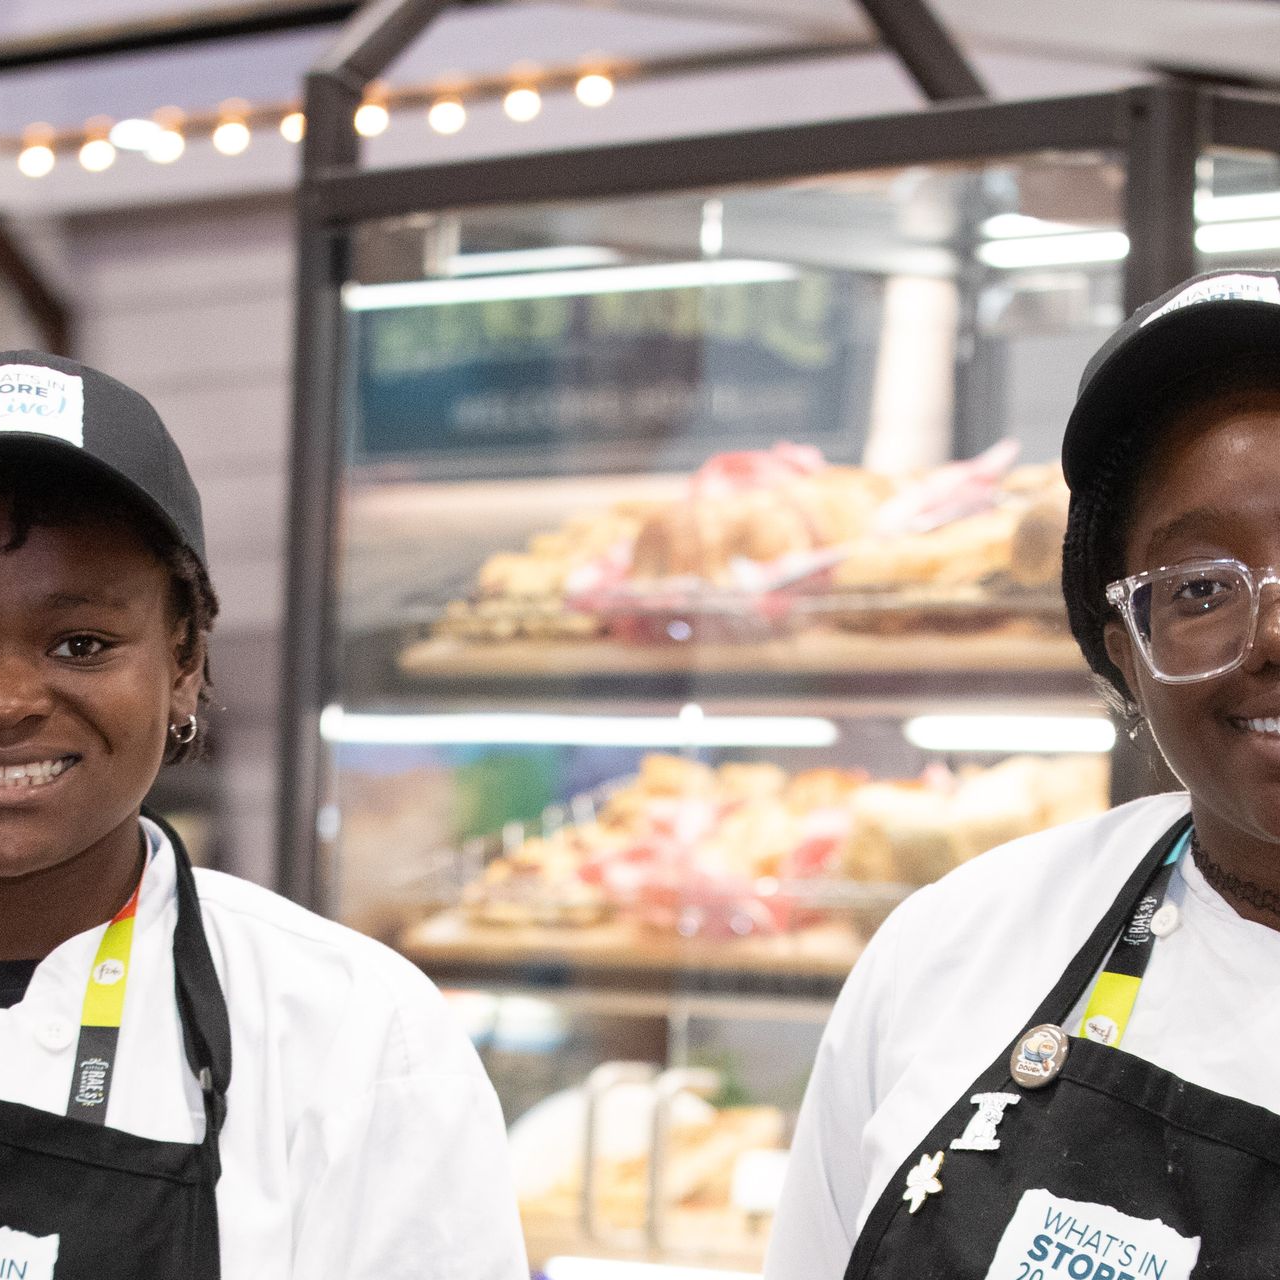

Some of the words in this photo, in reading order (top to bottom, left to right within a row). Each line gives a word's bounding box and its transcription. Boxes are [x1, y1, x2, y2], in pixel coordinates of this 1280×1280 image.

[48, 379, 66, 392] IN
[1043, 1206, 1136, 1267] WHAT'S
[1138, 1251, 1168, 1280] IN
[0, 1258, 28, 1280] IN
